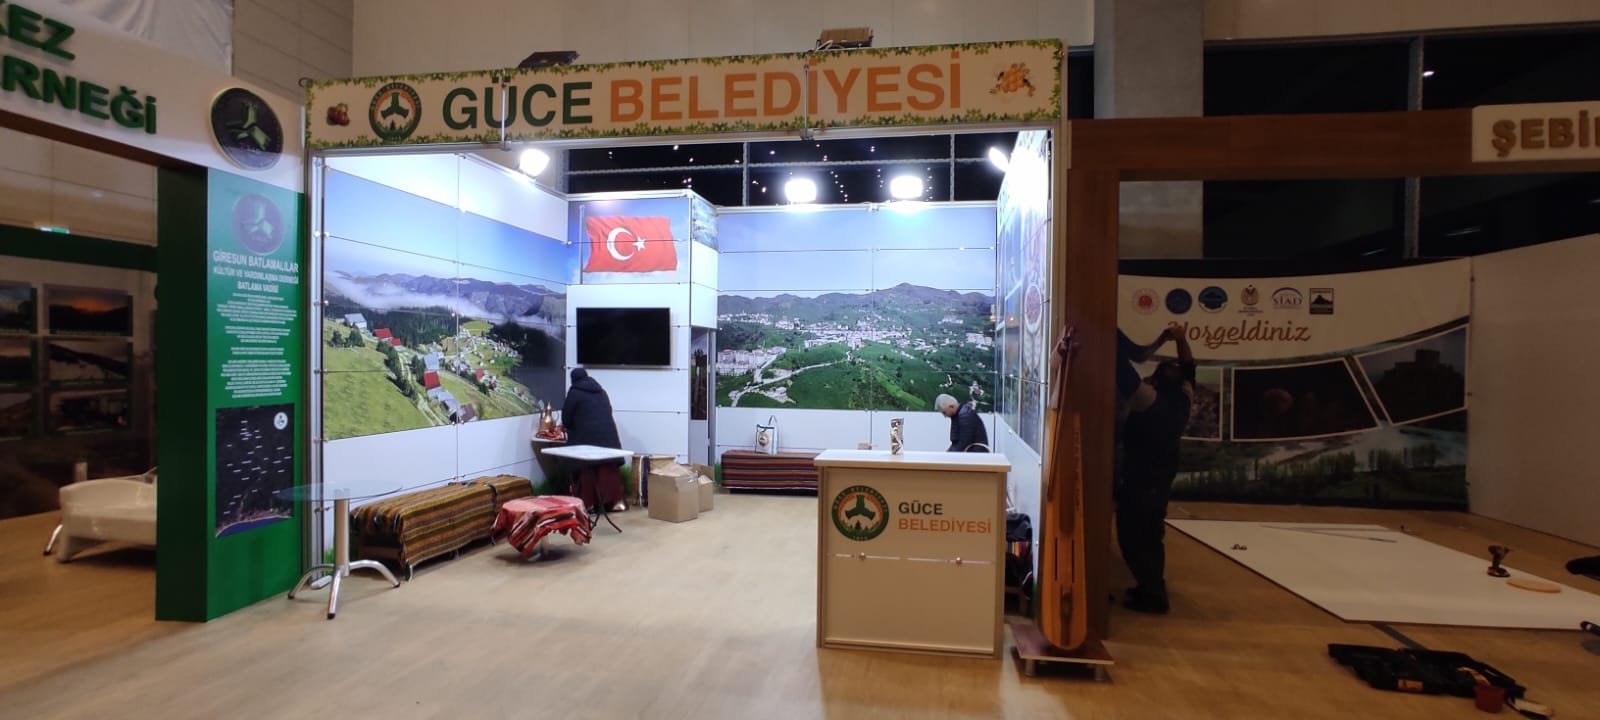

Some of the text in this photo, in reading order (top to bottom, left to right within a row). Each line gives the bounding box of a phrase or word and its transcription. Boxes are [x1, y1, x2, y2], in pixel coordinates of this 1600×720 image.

[0, 55, 157, 134] RNEĞİ
[442, 76, 593, 130] GÜCE
[610, 51, 960, 122] BELEDİYESİ
[213, 249, 247, 265] GİRESUN
[898, 500, 943, 515] GÜCE
[898, 517, 992, 534] BELEDİYESİ
